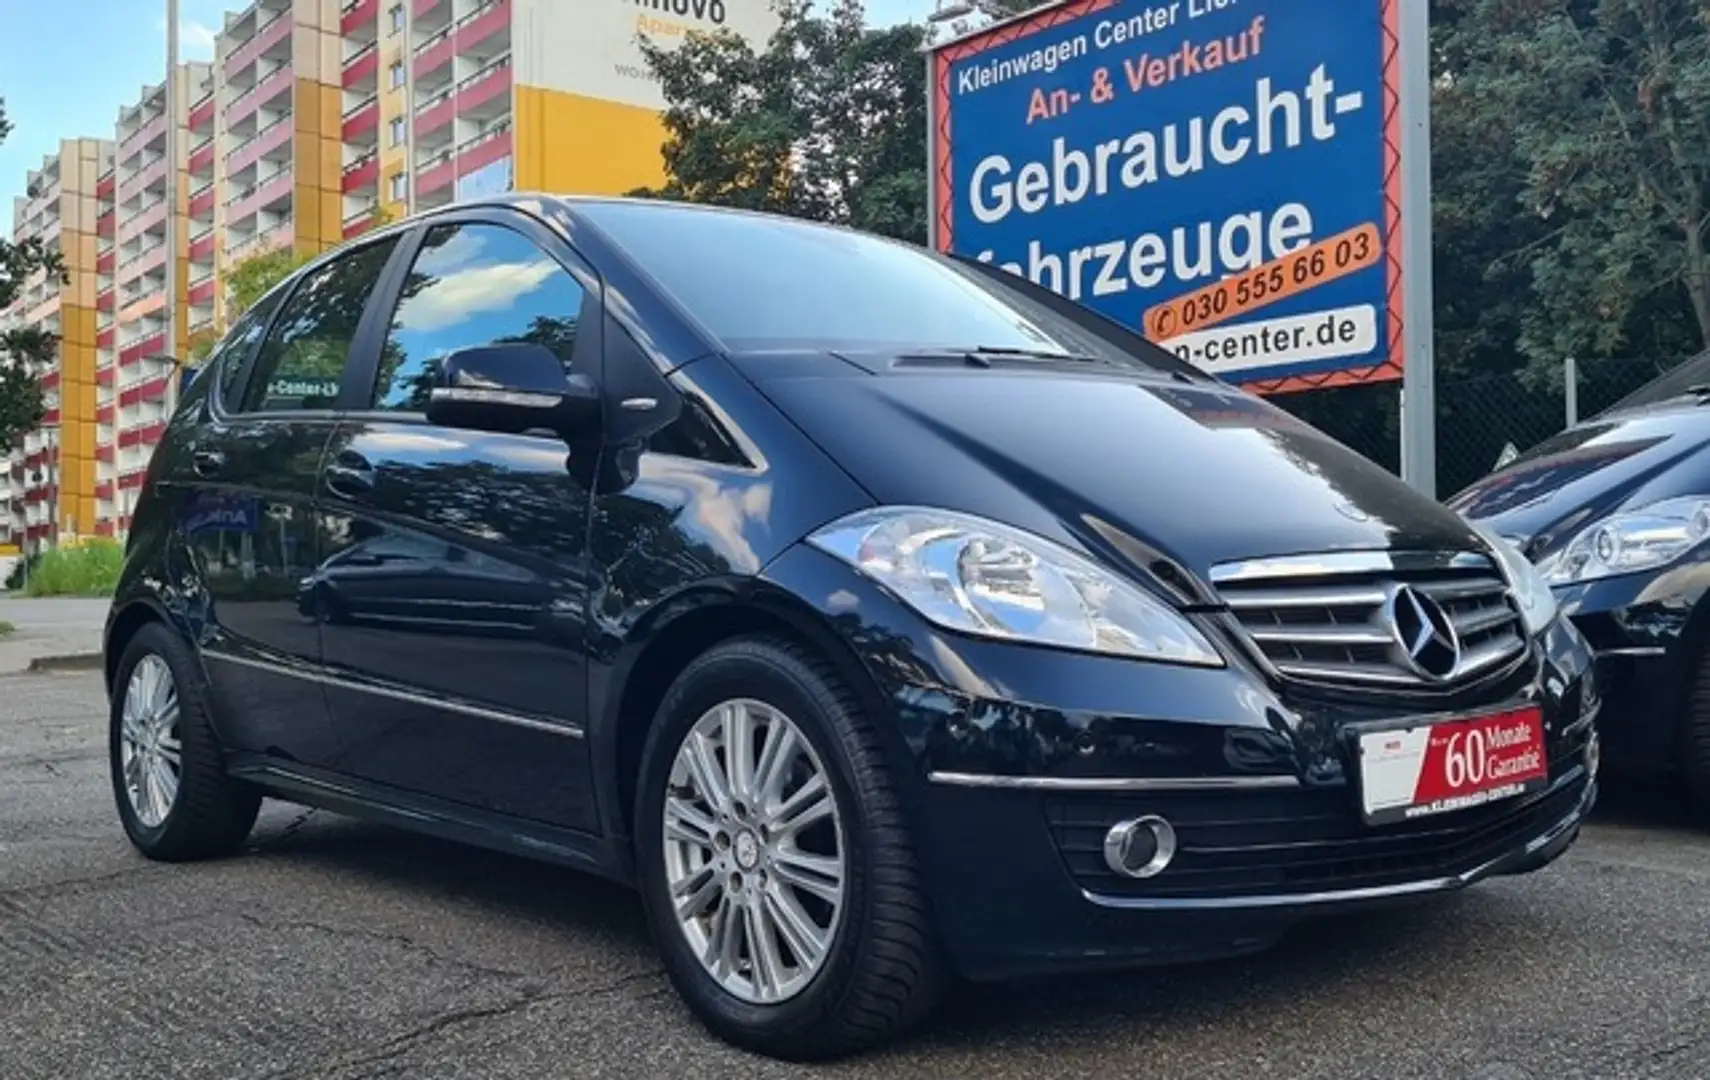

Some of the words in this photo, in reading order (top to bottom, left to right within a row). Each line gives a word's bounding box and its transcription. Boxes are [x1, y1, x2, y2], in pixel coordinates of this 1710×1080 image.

[957, 28, 1088, 96] Kleinwagen
[1095, 2, 1180, 50] Center
[1026, 88, 1081, 125] An-
[1090, 67, 1114, 104] &
[1123, 15, 1266, 93] Verkauf
[969, 63, 1363, 222] Gebraucht-
[977, 201, 1314, 301] hrzeuge
[1182, 287, 1228, 326] 030
[1235, 265, 1284, 306] 555
[1293, 249, 1325, 283] 66
[1335, 232, 1369, 268] 03
[1445, 729, 1485, 788] 60
[1485, 721, 1532, 750] Monate
